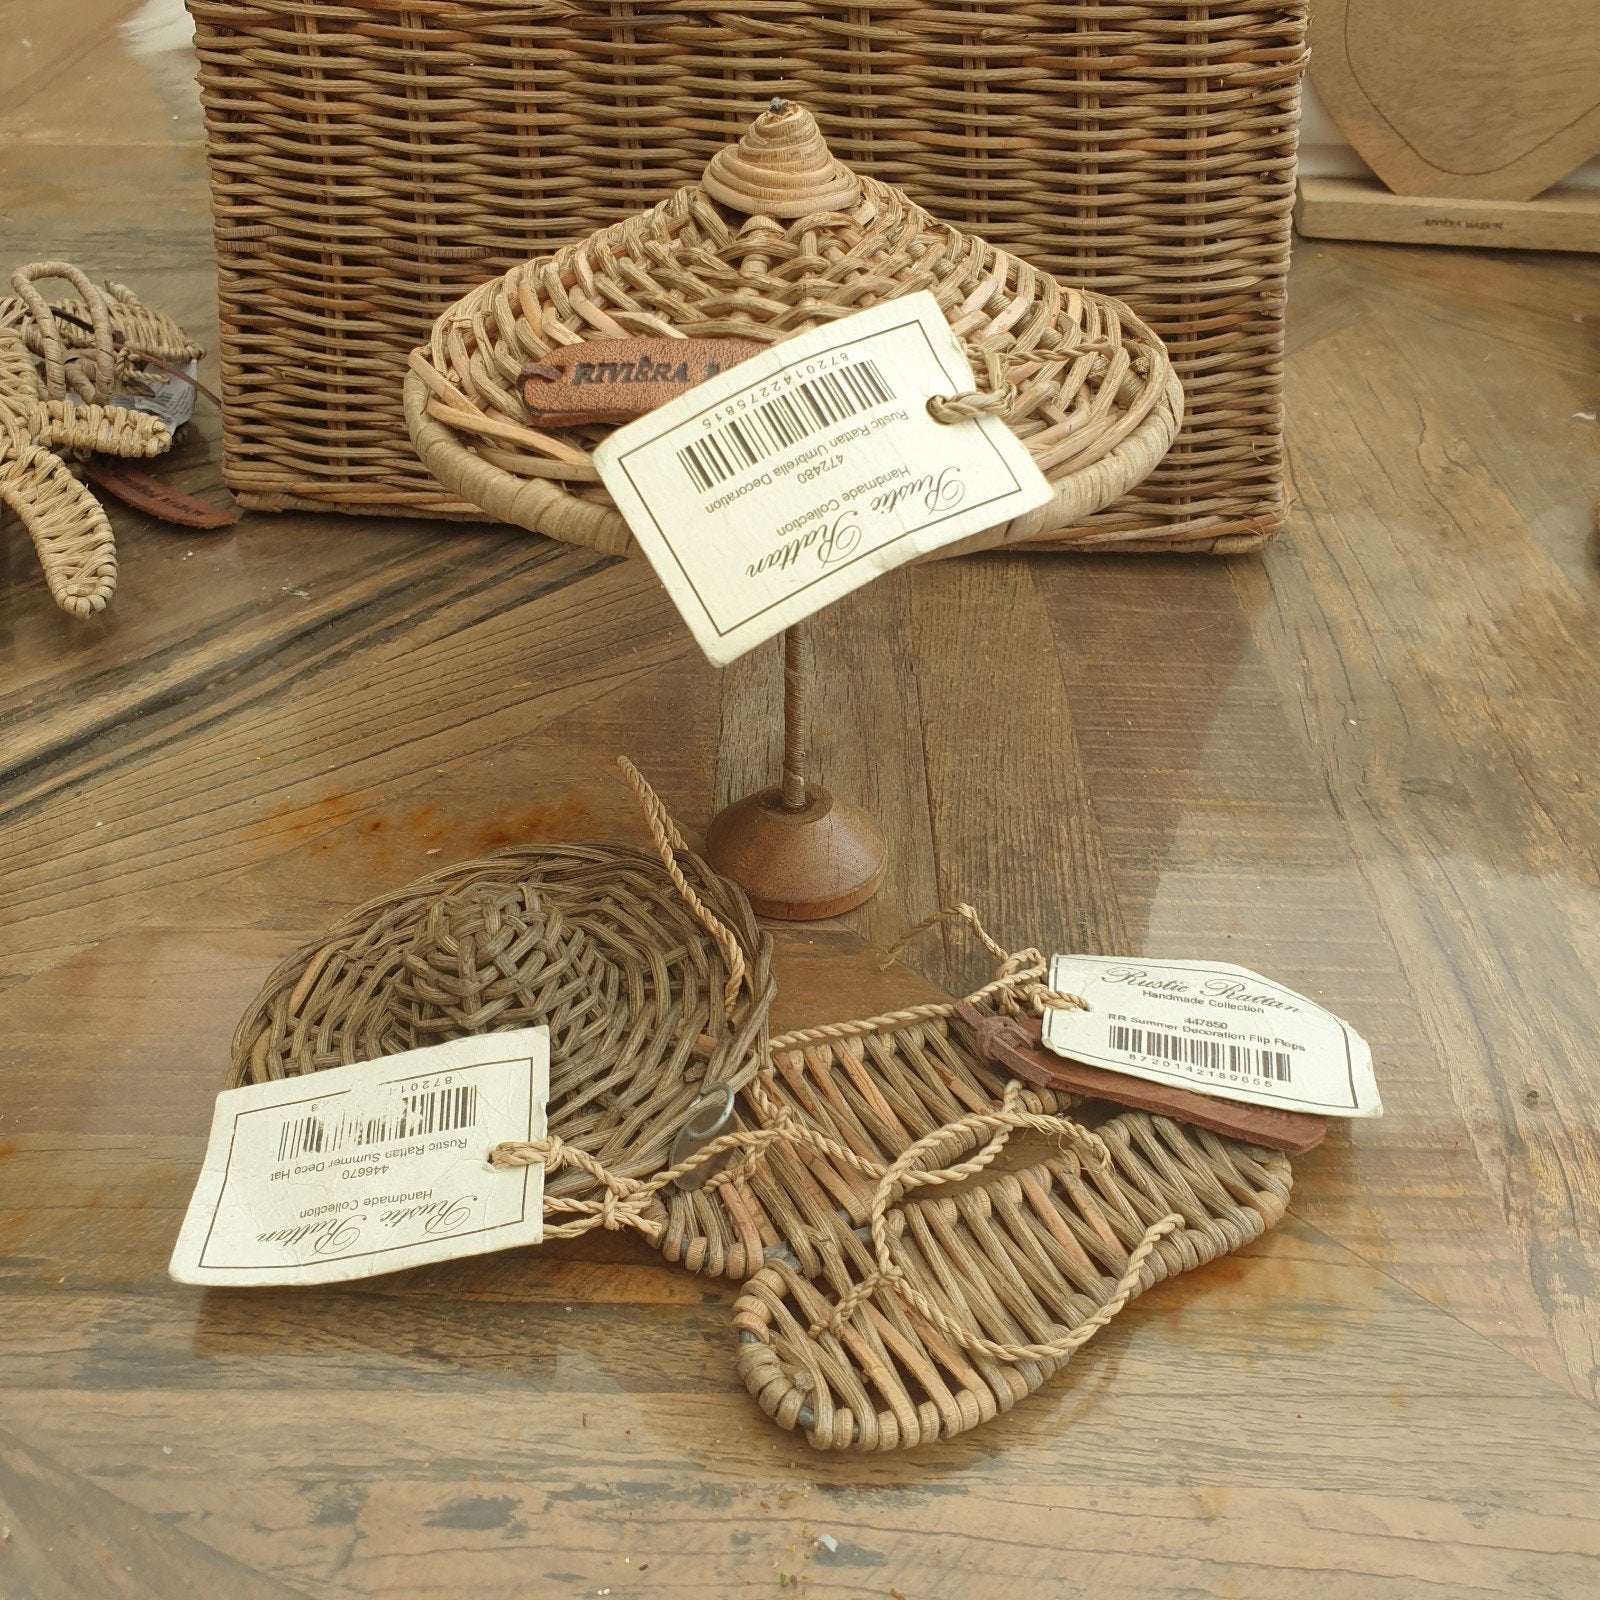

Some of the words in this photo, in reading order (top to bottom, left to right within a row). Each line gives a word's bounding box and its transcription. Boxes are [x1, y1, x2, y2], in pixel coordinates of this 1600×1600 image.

[702, 352, 848, 429] 8720142275815
[870, 409, 909, 431] Rustic
[829, 423, 870, 450] Rattan
[772, 443, 828, 478] Umbrella
[796, 454, 844, 484] 472480
[704, 473, 772, 515] Decoration
[841, 465, 911, 503] Handmade
[869, 466, 965, 515] Rustic
[776, 498, 840, 537] Collection
[745, 510, 862, 578] Rattan
[1101, 967, 1189, 992] Rustic
[1199, 978, 1302, 1013] Rattan
[1142, 990, 1204, 1005] Handmade
[1208, 999, 1265, 1014] Collection
[1107, 1013, 1127, 1021] RR
[1130, 1017, 1178, 1031] Summer
[1182, 1026, 1246, 1041] Decoration
[1249, 1034, 1271, 1045] Flip
[1274, 1038, 1306, 1052] Flops
[1184, 1017, 1228, 1030] 447850
[1128, 1054, 1273, 1088] 8720142189655
[329, 1153, 381, 1168] Summer
[384, 1145, 425, 1160] Rattan
[429, 1138, 468, 1153] Rustic
[270, 1170, 291, 1182] Hat
[294, 1162, 325, 1176] Deco
[341, 1164, 390, 1180] 446670
[299, 1200, 359, 1220] Collection
[363, 1189, 433, 1208] Handmade
[379, 1195, 478, 1236] Rustic
[255, 1214, 367, 1256] Rattan
